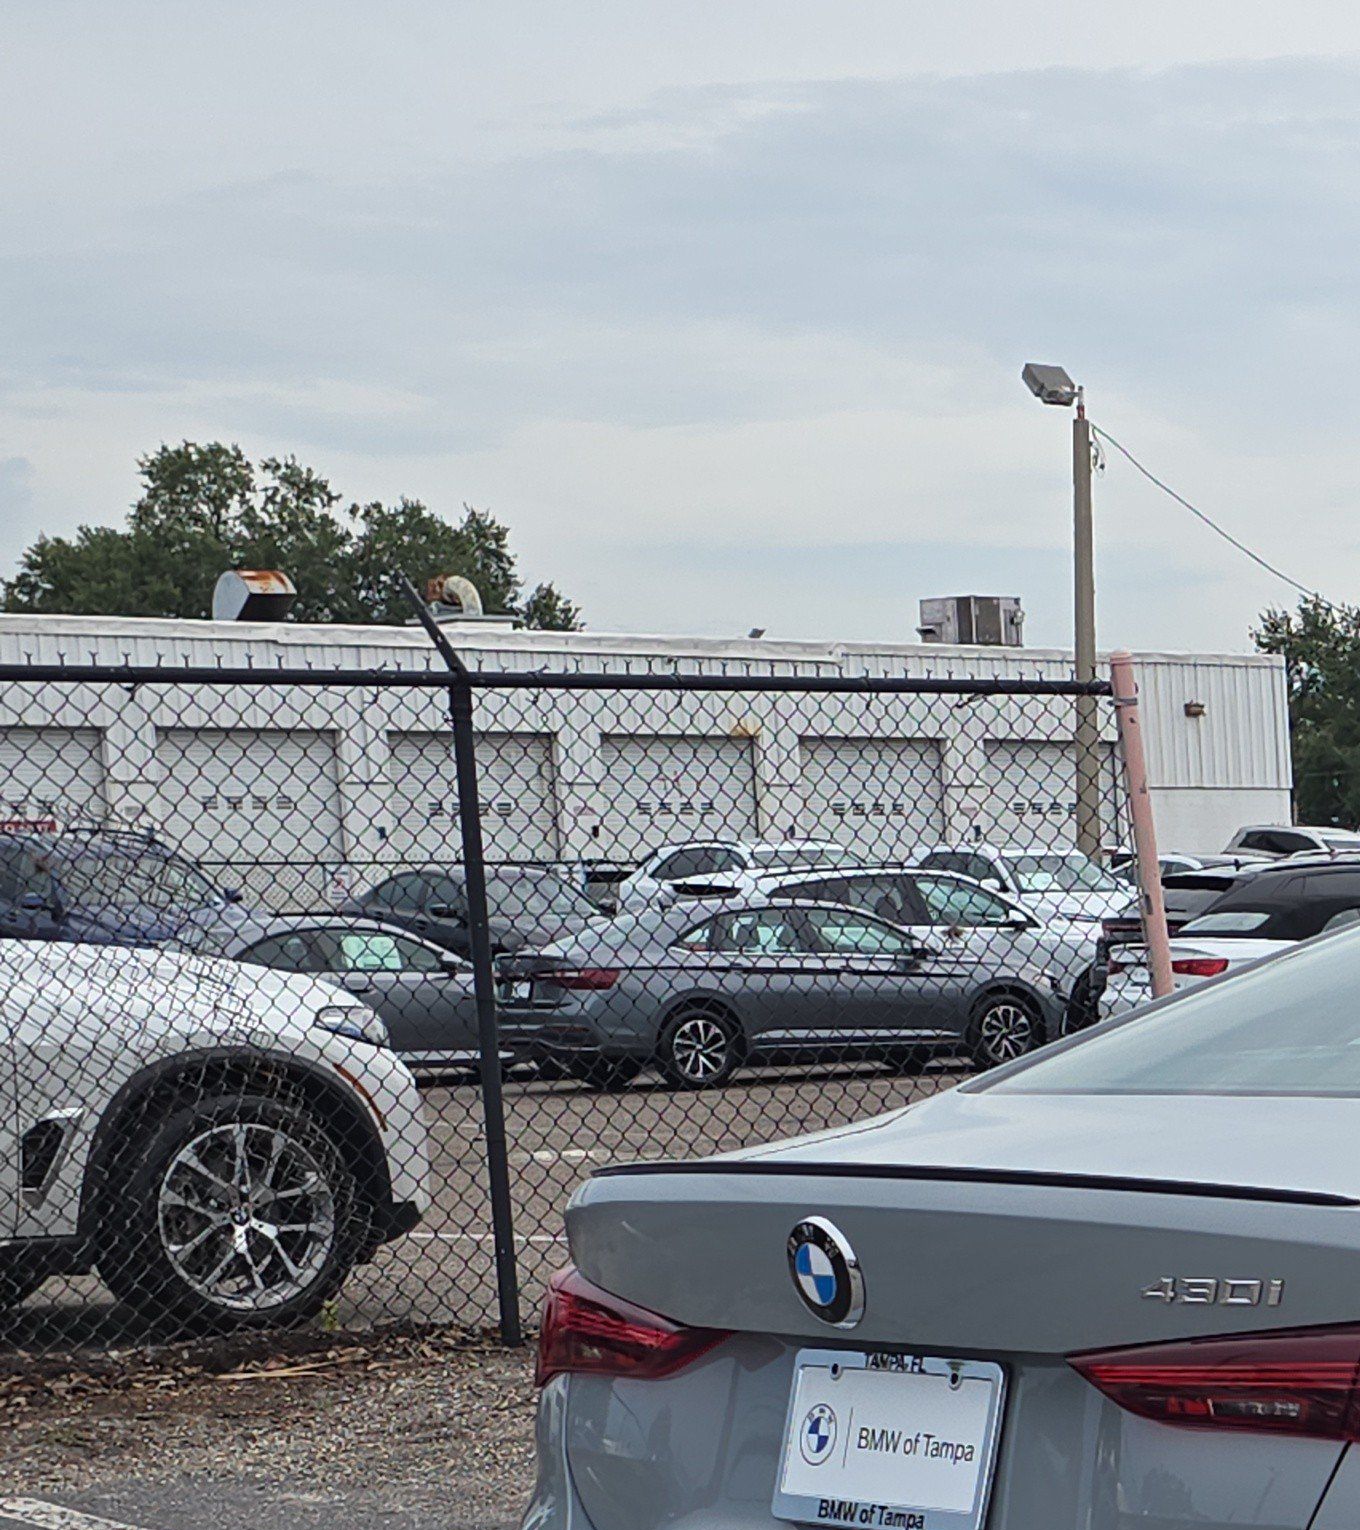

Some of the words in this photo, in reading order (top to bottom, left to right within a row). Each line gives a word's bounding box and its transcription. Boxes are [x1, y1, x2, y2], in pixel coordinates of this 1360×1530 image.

[1140, 1275, 1286, 1307] 430i
[911, 1354, 927, 1374] FL
[857, 1427, 903, 1454] BMW
[903, 1432, 921, 1455] of
[922, 1433, 975, 1465] Tampa
[817, 1499, 860, 1523] BMW
[859, 1504, 877, 1524] of
